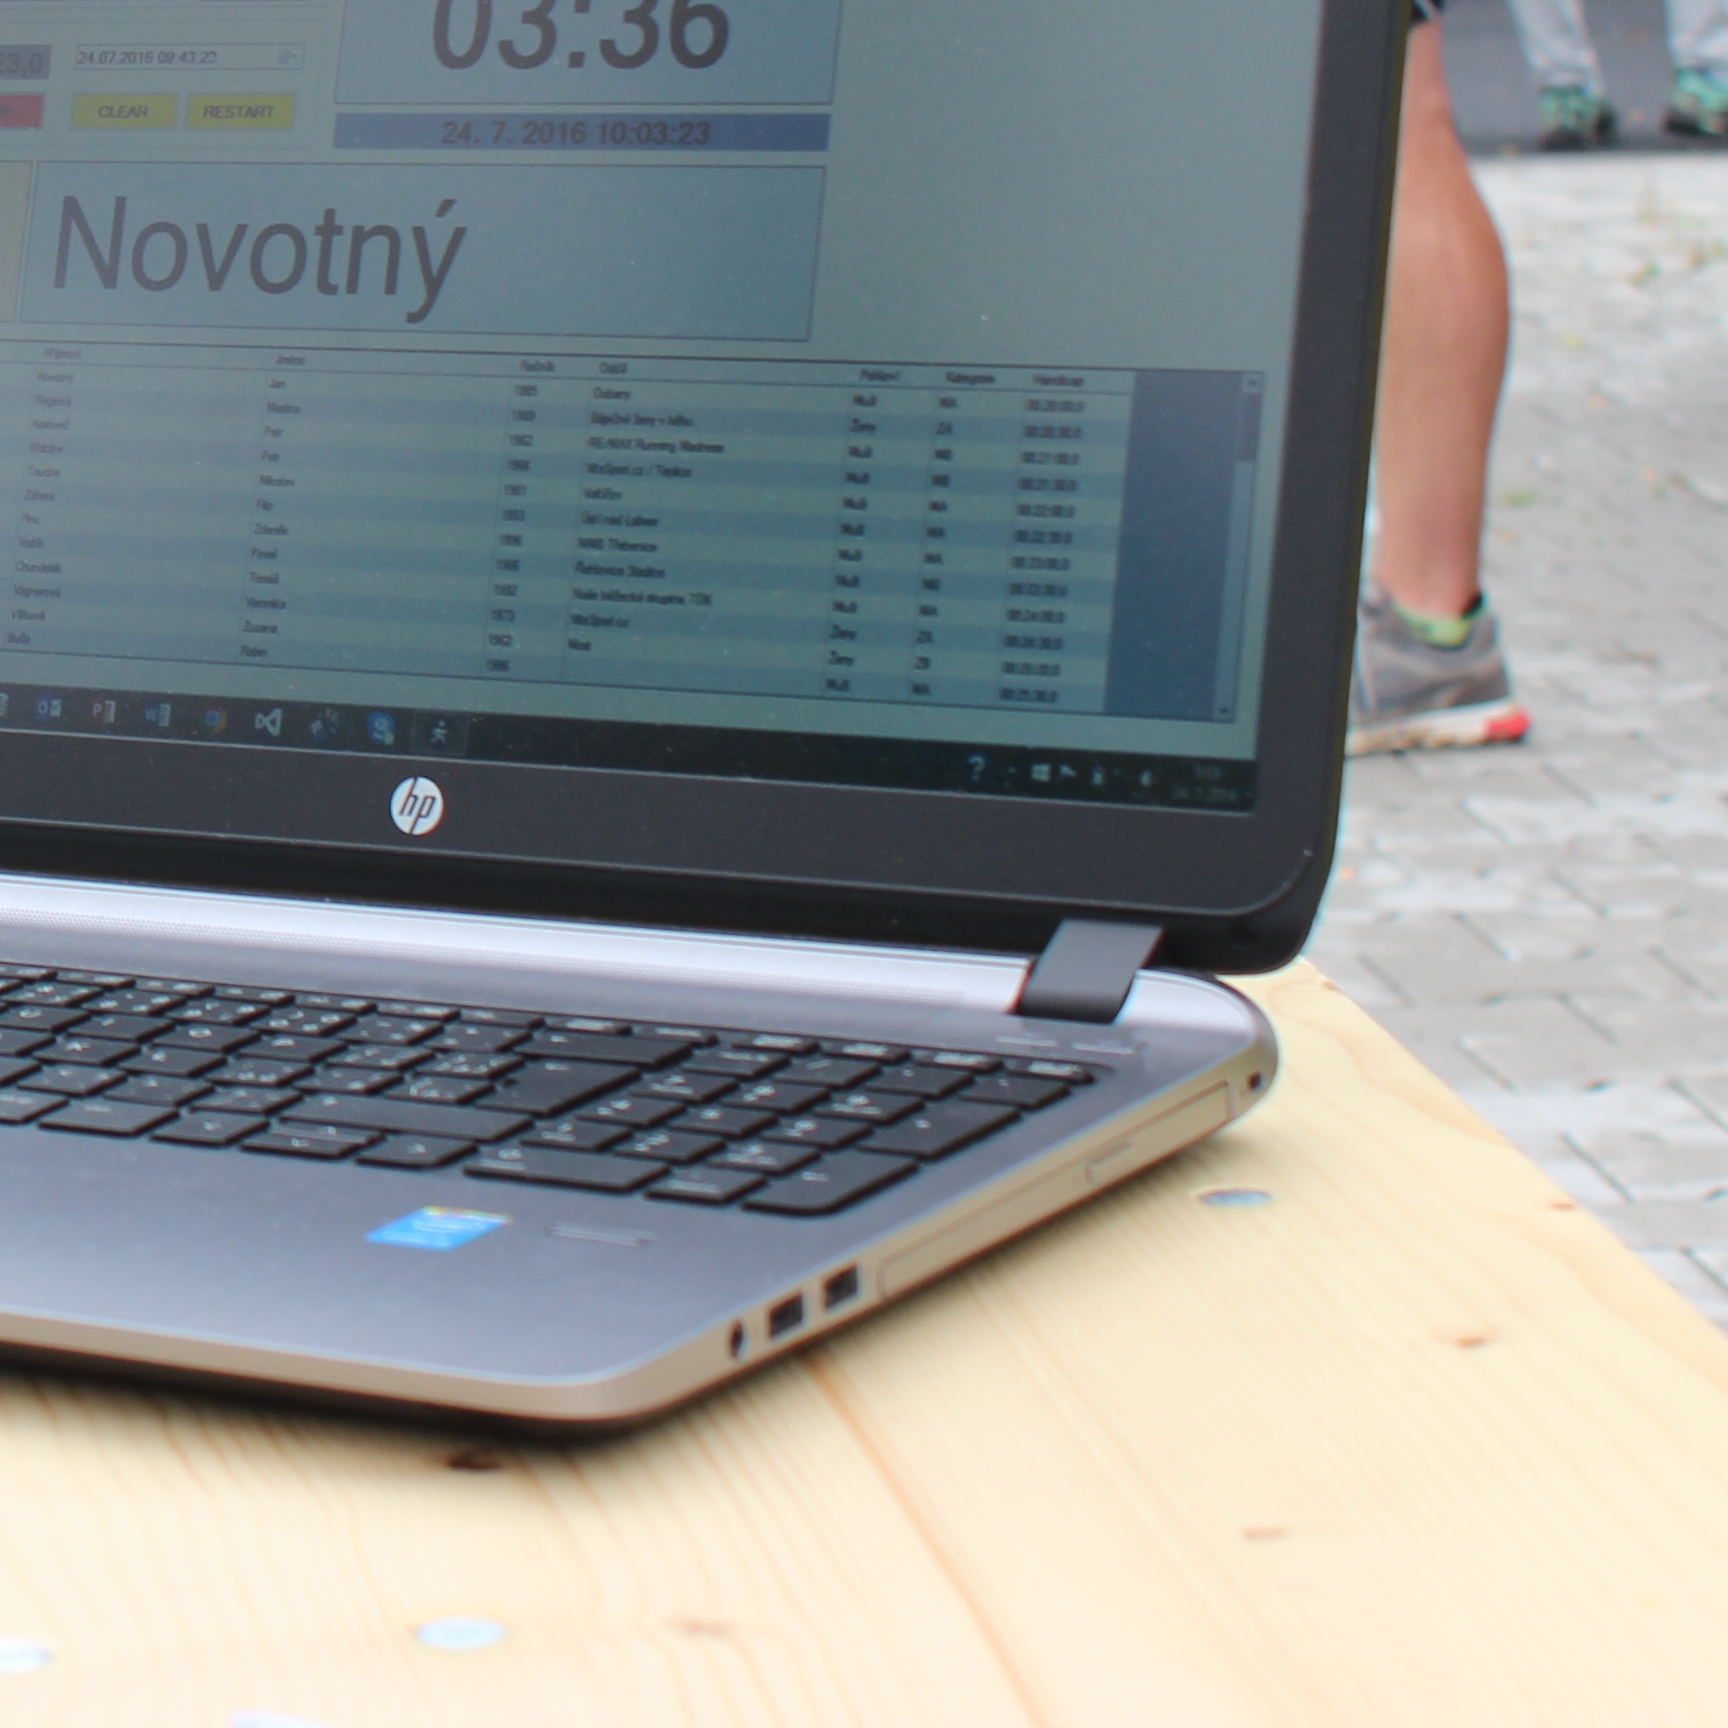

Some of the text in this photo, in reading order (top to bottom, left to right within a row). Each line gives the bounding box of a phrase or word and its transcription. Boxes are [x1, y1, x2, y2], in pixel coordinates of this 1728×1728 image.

[98, 104, 149, 120] CLEAR
[202, 104, 276, 120] RESTART
[441, 121, 480, 144] 24.
[521, 121, 586, 144] 2016
[599, 121, 711, 144] 10:03:23
[53, 193, 467, 324] Novotný
[397, 777, 437, 835] hp
